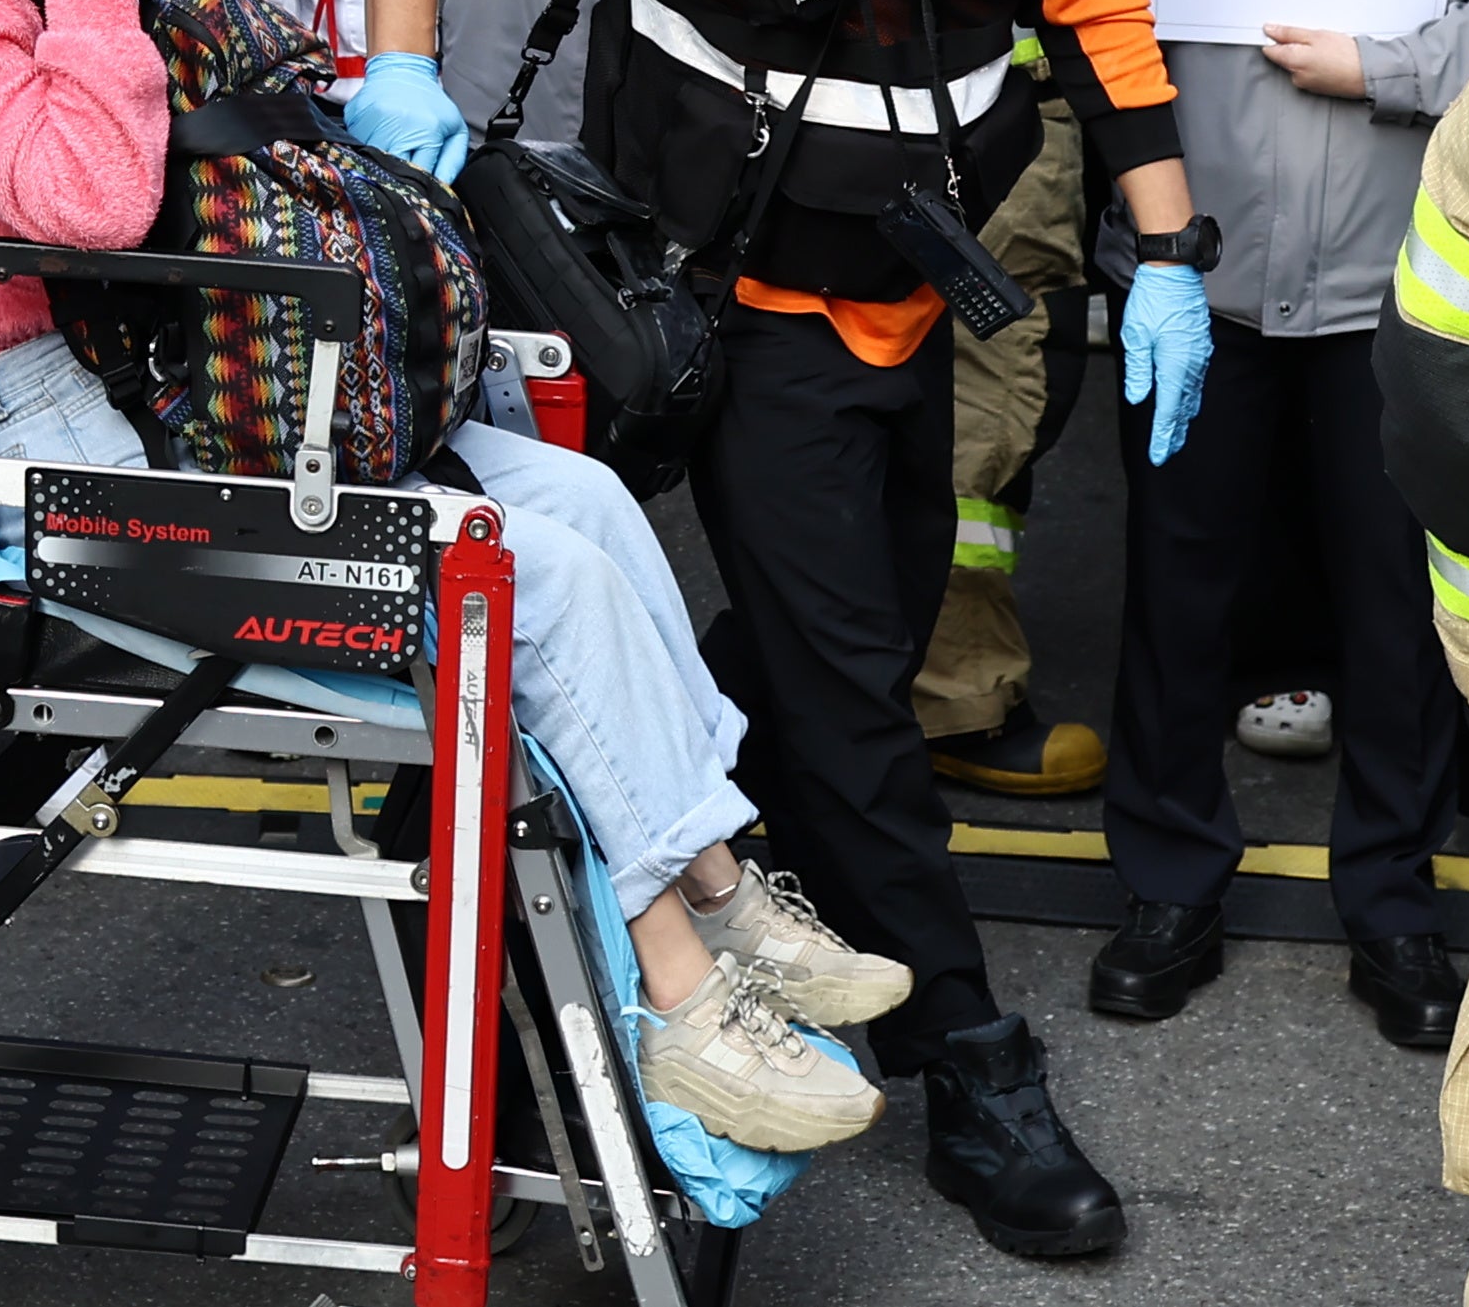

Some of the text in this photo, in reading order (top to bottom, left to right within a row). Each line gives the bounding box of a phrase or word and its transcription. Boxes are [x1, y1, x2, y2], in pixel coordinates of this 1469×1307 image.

[45, 512, 210, 543] Mobile System
[297, 561, 404, 587] AT- N161
[233, 616, 404, 653] AUTECH
